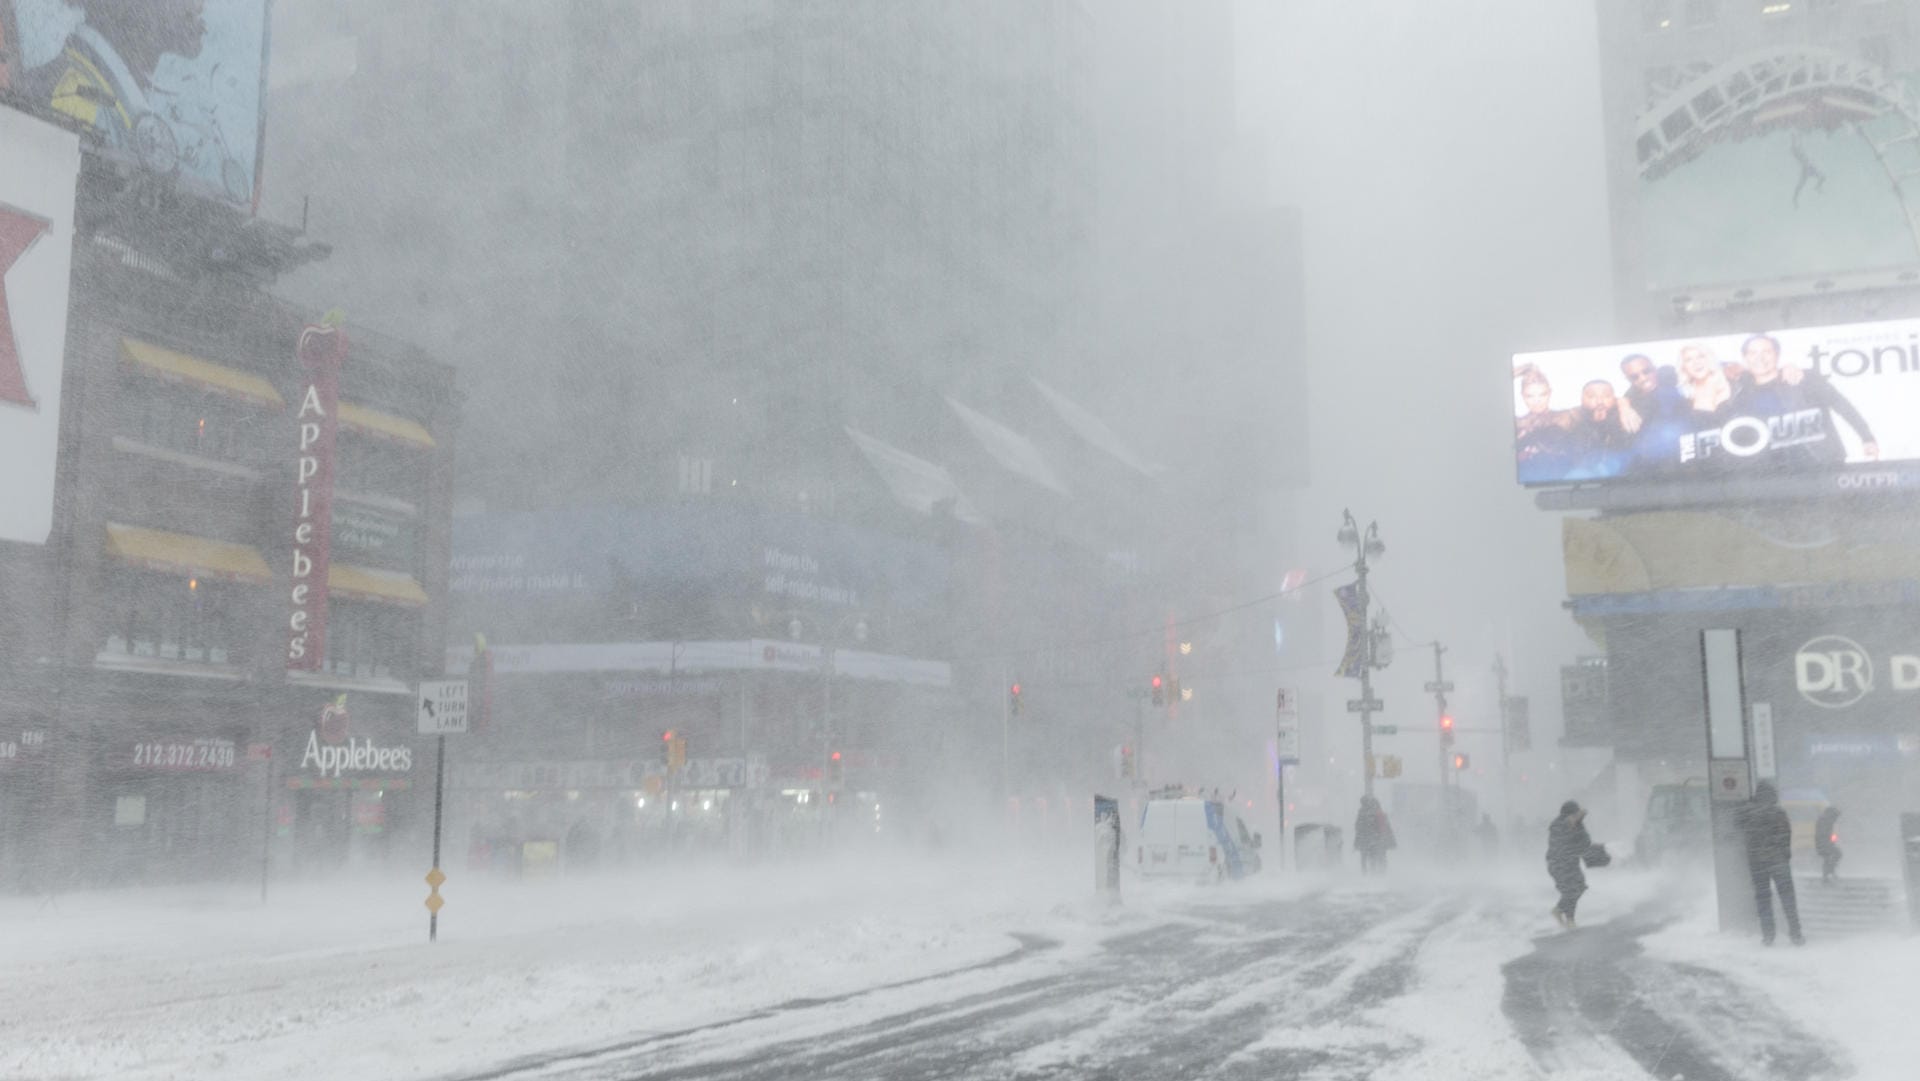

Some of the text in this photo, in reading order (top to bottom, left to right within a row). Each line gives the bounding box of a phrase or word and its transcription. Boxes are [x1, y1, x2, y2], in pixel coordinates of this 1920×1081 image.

[1808, 333, 1920, 377] toni
[1696, 408, 1825, 459] FOUR
[289, 384, 326, 660] Applebee's
[764, 547, 800, 571] Where
[438, 685, 465, 698] LEFT
[438, 700, 465, 713] TURN
[436, 715, 465, 730] LANE
[300, 729, 413, 778] Applebee's
